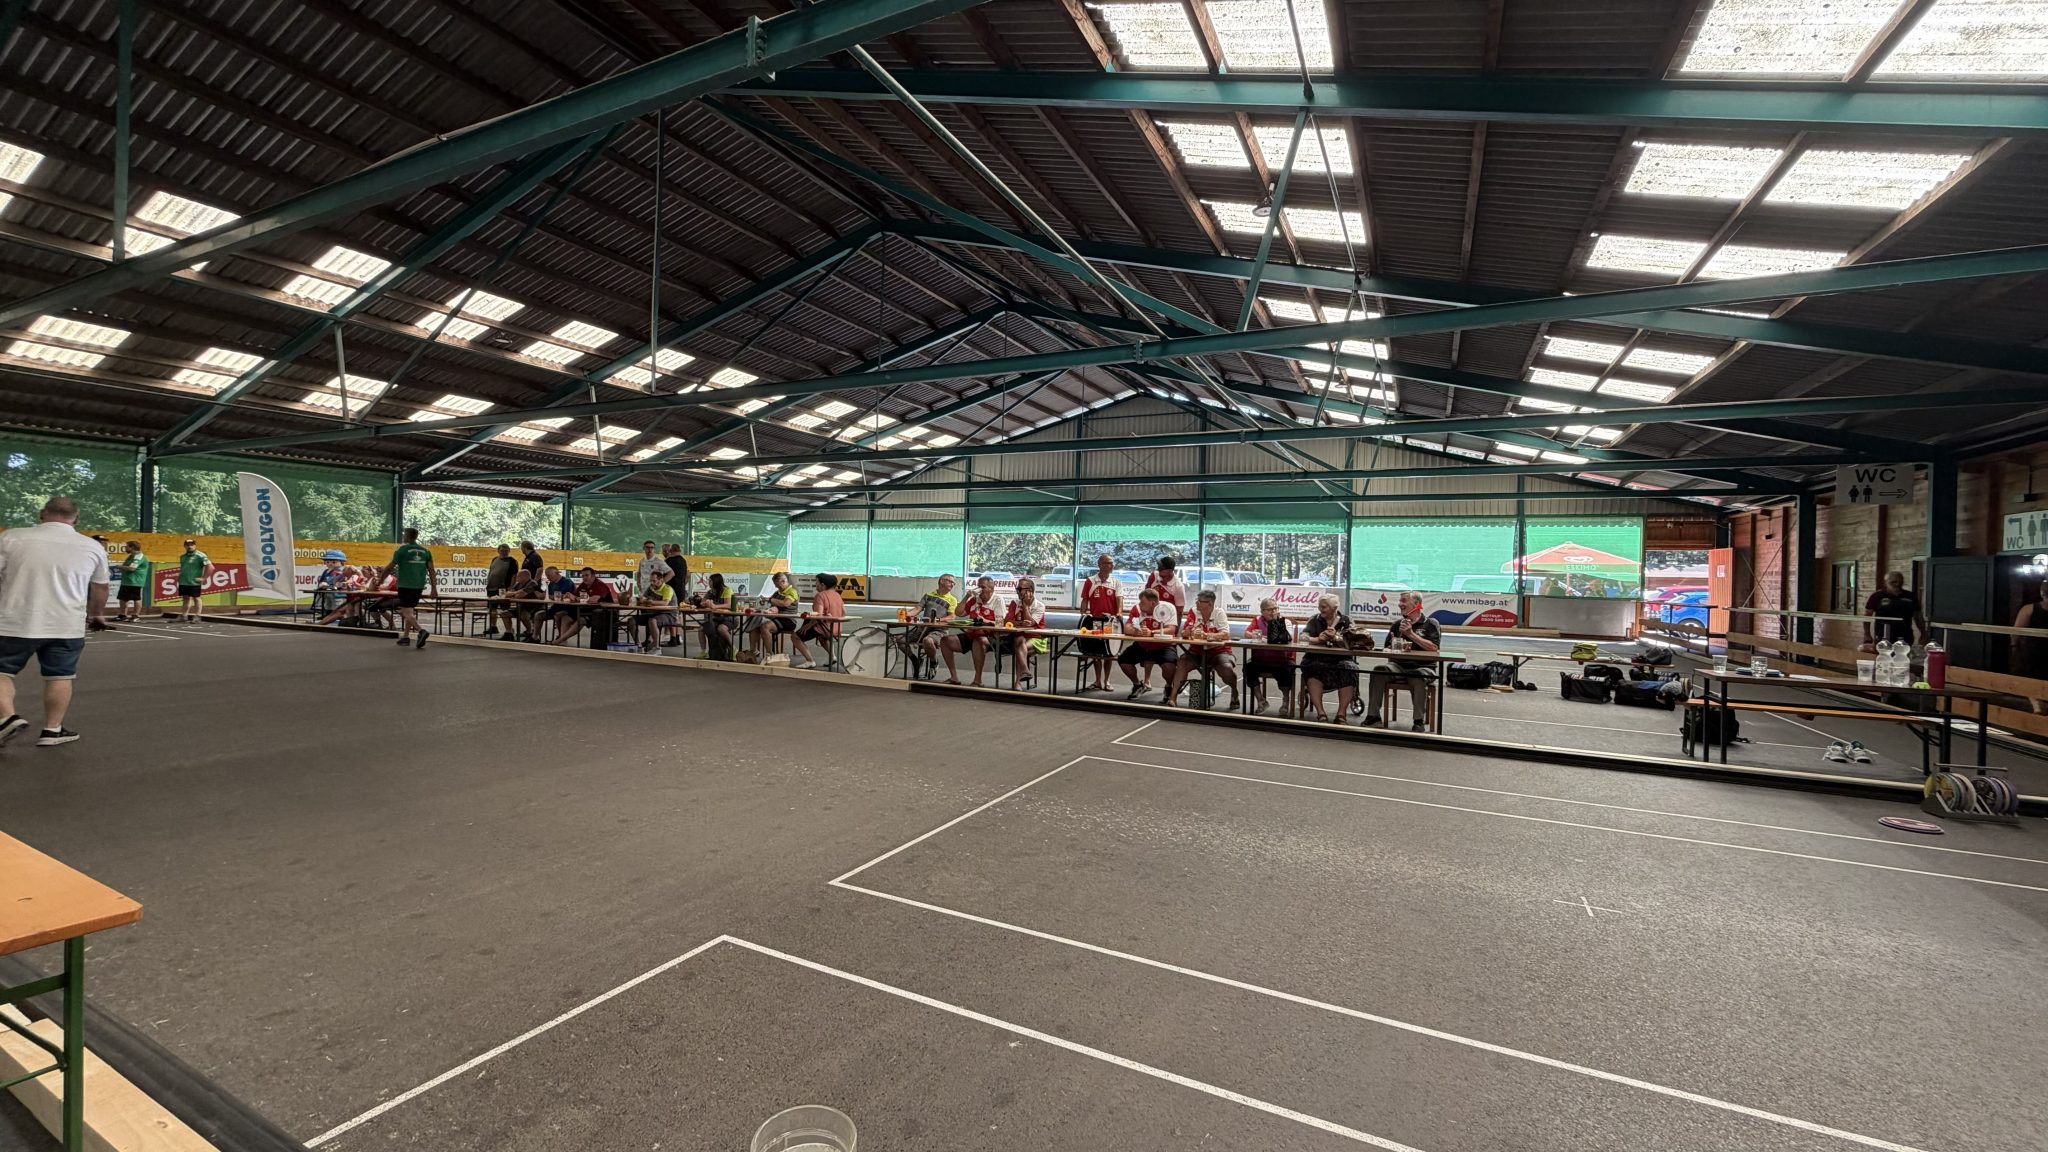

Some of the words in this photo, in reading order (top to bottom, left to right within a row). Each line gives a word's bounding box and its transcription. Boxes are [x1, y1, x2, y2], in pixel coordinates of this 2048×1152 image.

[1855, 468, 1897, 483] WC
[256, 488, 277, 566] POLYGON
[2006, 535, 2024, 549] WC
[1271, 587, 1320, 604] Meidl
[1441, 597, 1509, 607] www.mibag.at
[1350, 602, 1390, 616] mibag
